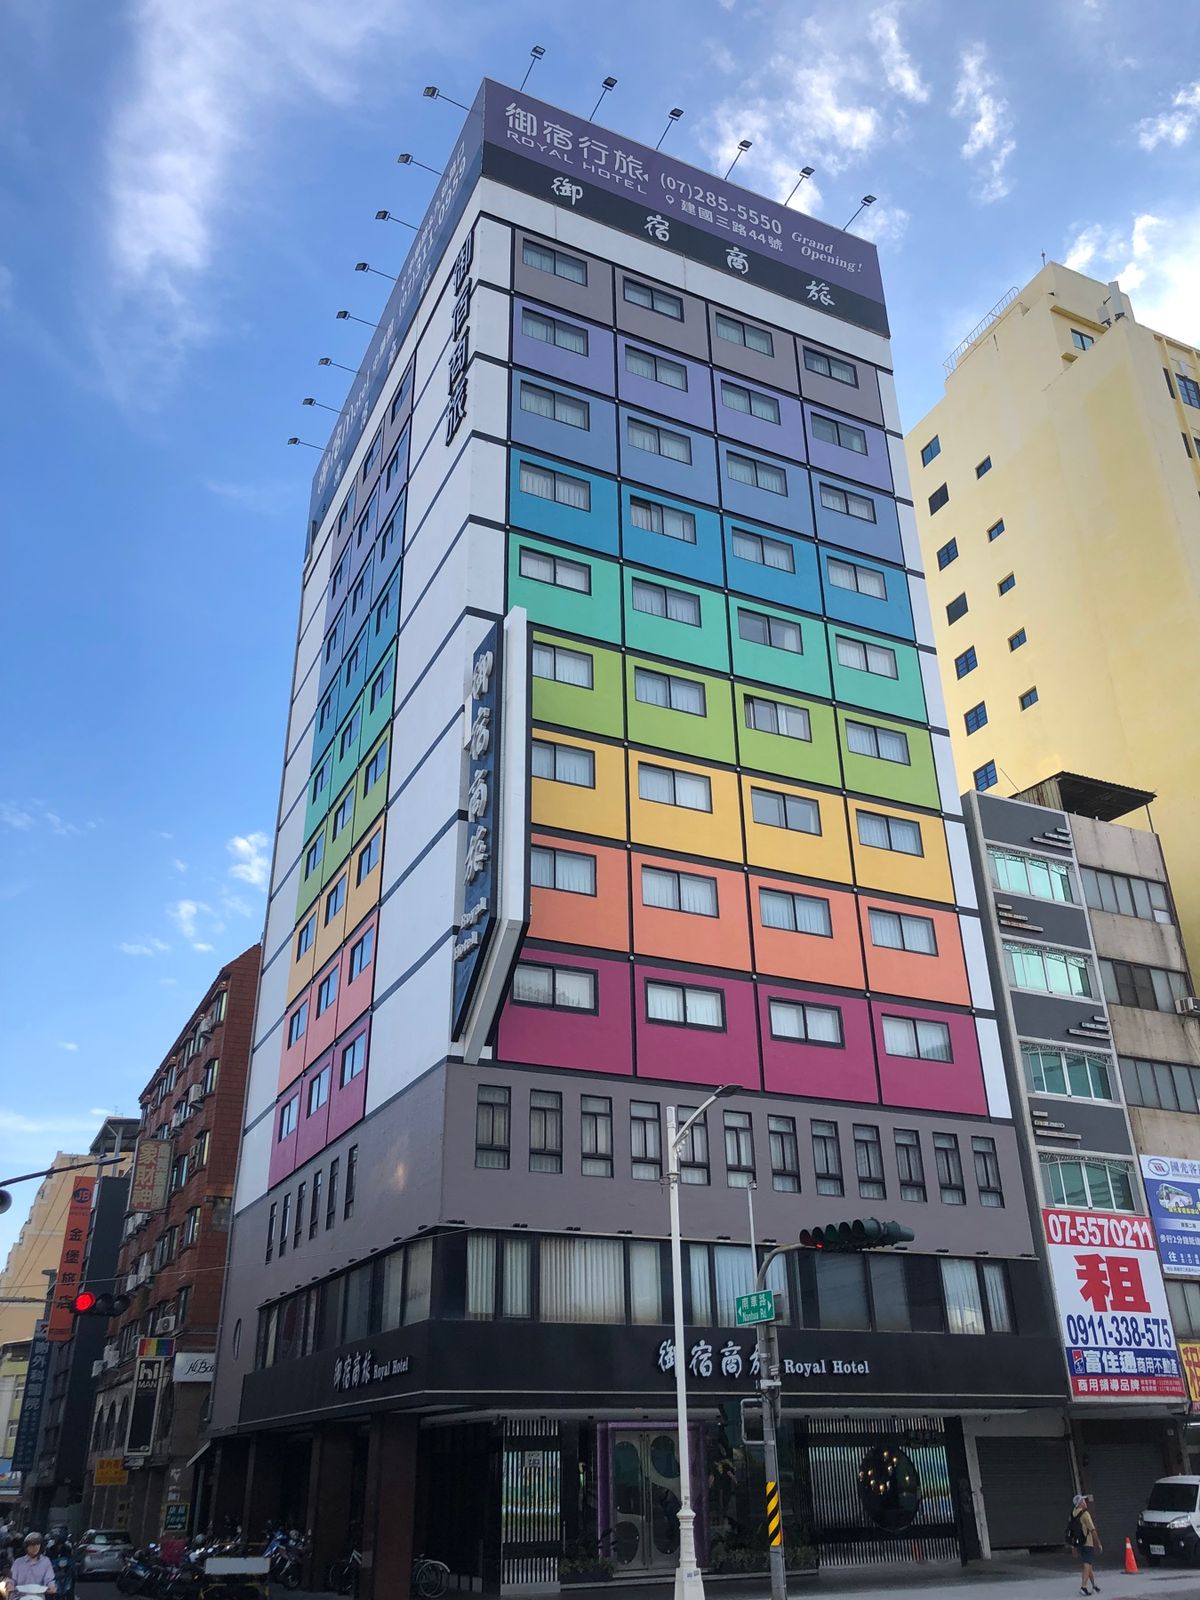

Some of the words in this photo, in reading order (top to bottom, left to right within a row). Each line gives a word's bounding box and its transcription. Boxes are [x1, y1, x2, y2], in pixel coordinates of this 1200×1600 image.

[506, 102, 649, 181] 御宿行旅
[507, 130, 574, 164] ROYAL
[583, 162, 647, 195] HOTEL
[660, 173, 782, 235] (07)285-5550
[681, 199, 783, 252] 建國三路44號
[791, 232, 834, 254] Grand
[801, 246, 863, 273] Opening!
[446, 229, 475, 447] 御宿商旅
[1170, 1161, 1200, 1177] 國光客
[1048, 1214, 1154, 1248] 07-5570211
[1074, 1254, 1151, 1313] 租
[1066, 1314, 1171, 1348] 0911-338-575
[784, 1359, 827, 1377] Royal
[832, 1360, 870, 1374] Hotel
